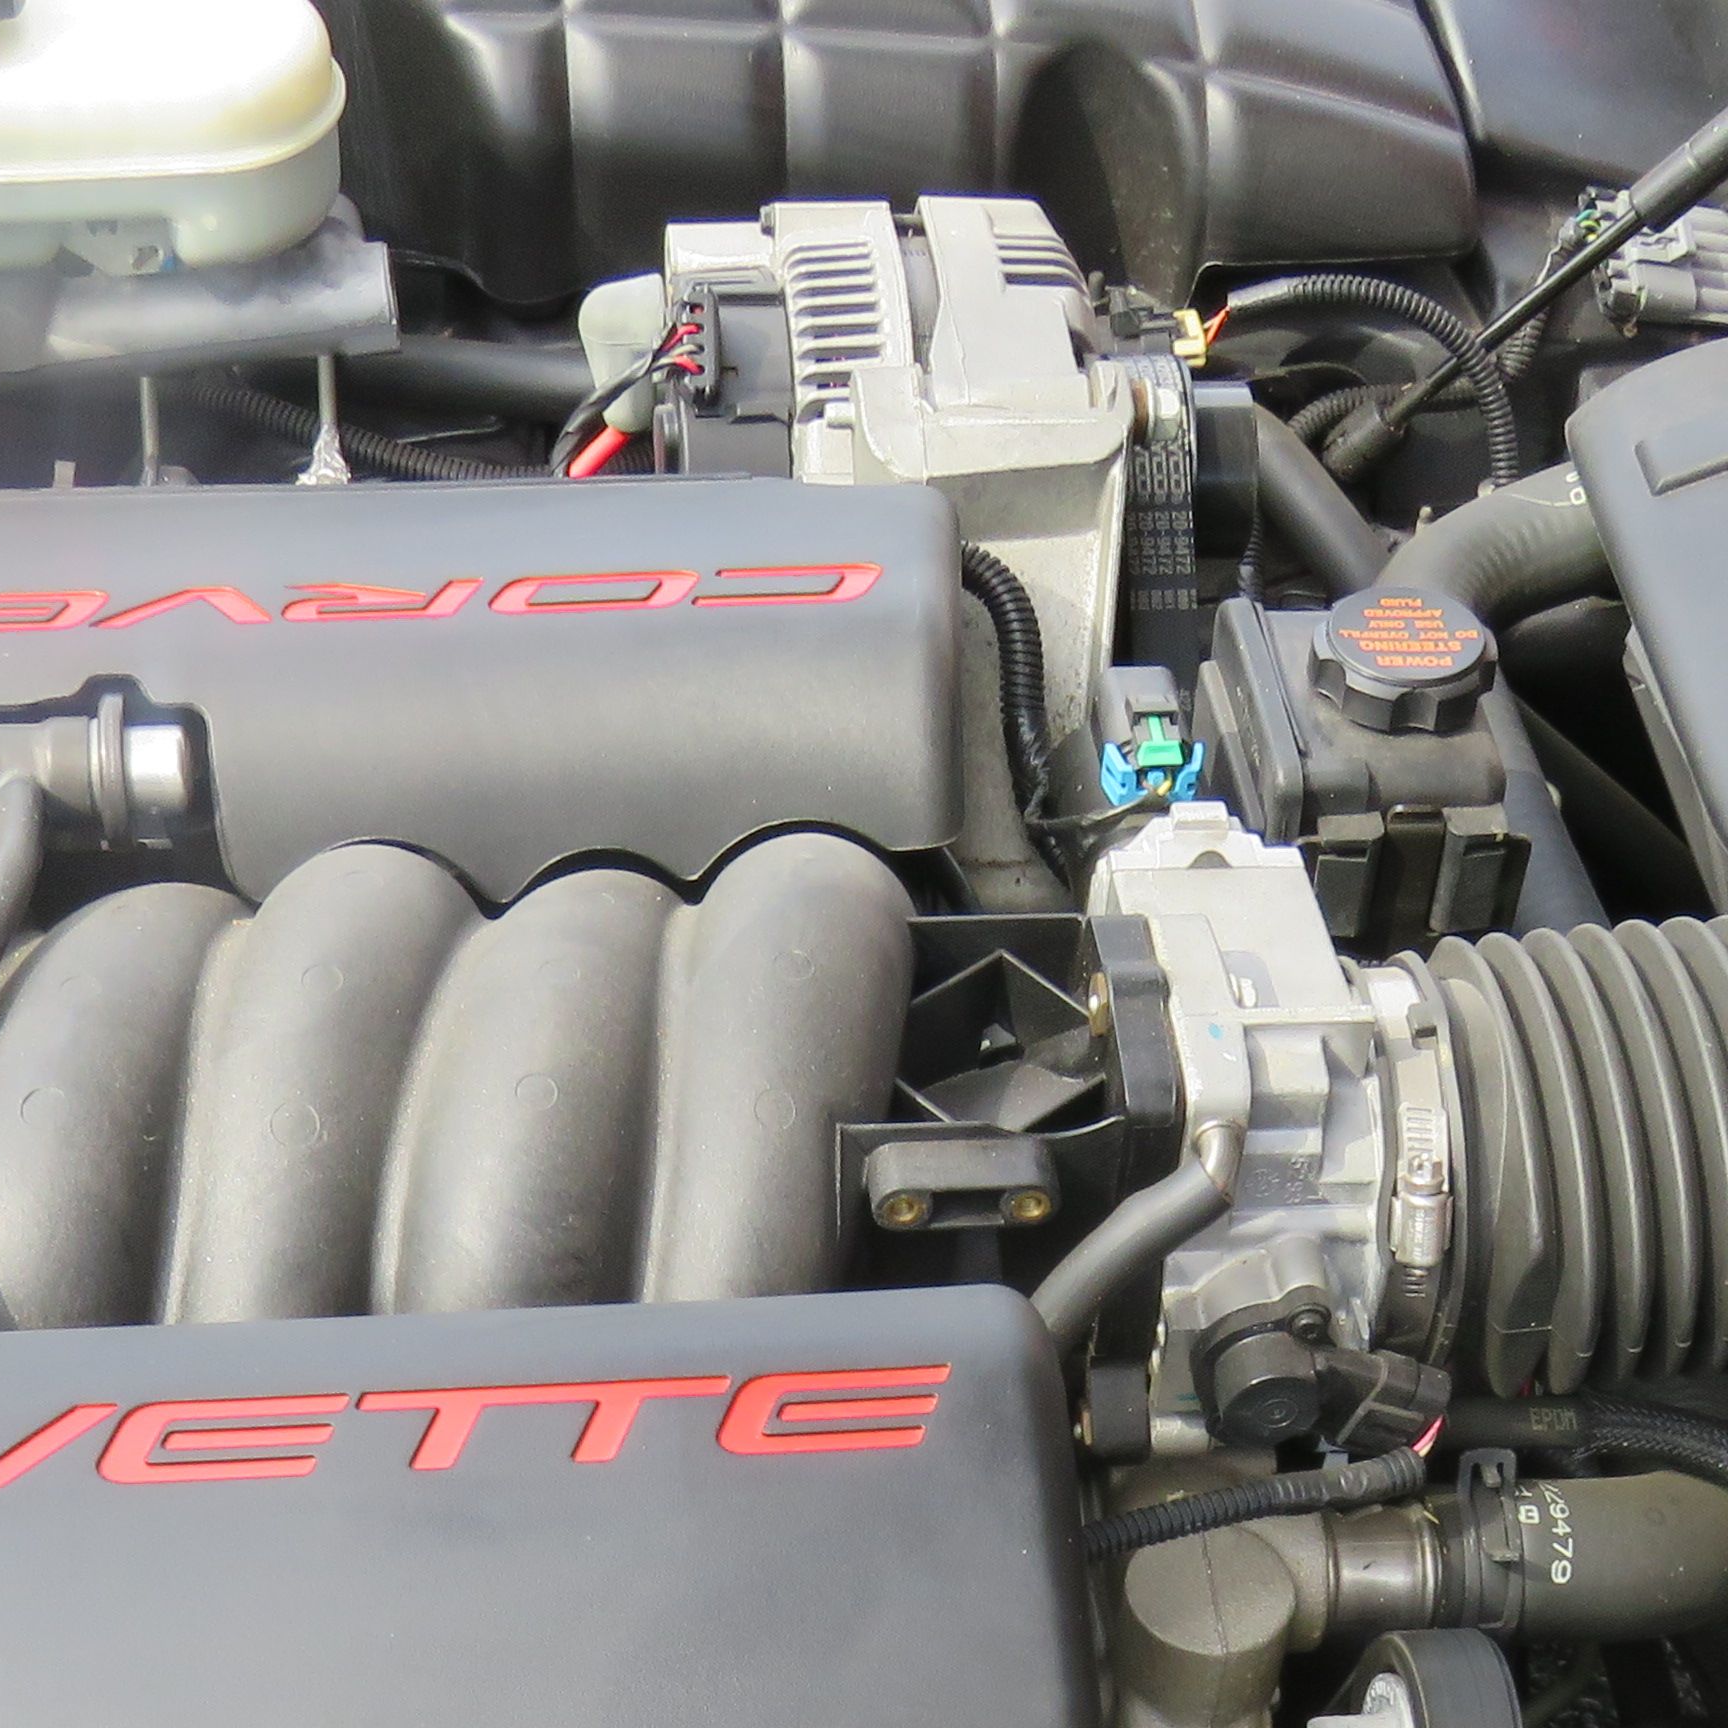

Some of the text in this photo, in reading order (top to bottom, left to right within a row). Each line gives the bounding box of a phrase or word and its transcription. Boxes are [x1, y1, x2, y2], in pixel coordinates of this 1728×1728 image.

[1455, 630, 1479, 639] DO
[1359, 641, 1462, 652] STEERING
[1376, 656, 1453, 668] POWER
[1530, 1408, 1577, 1431] EPDM
